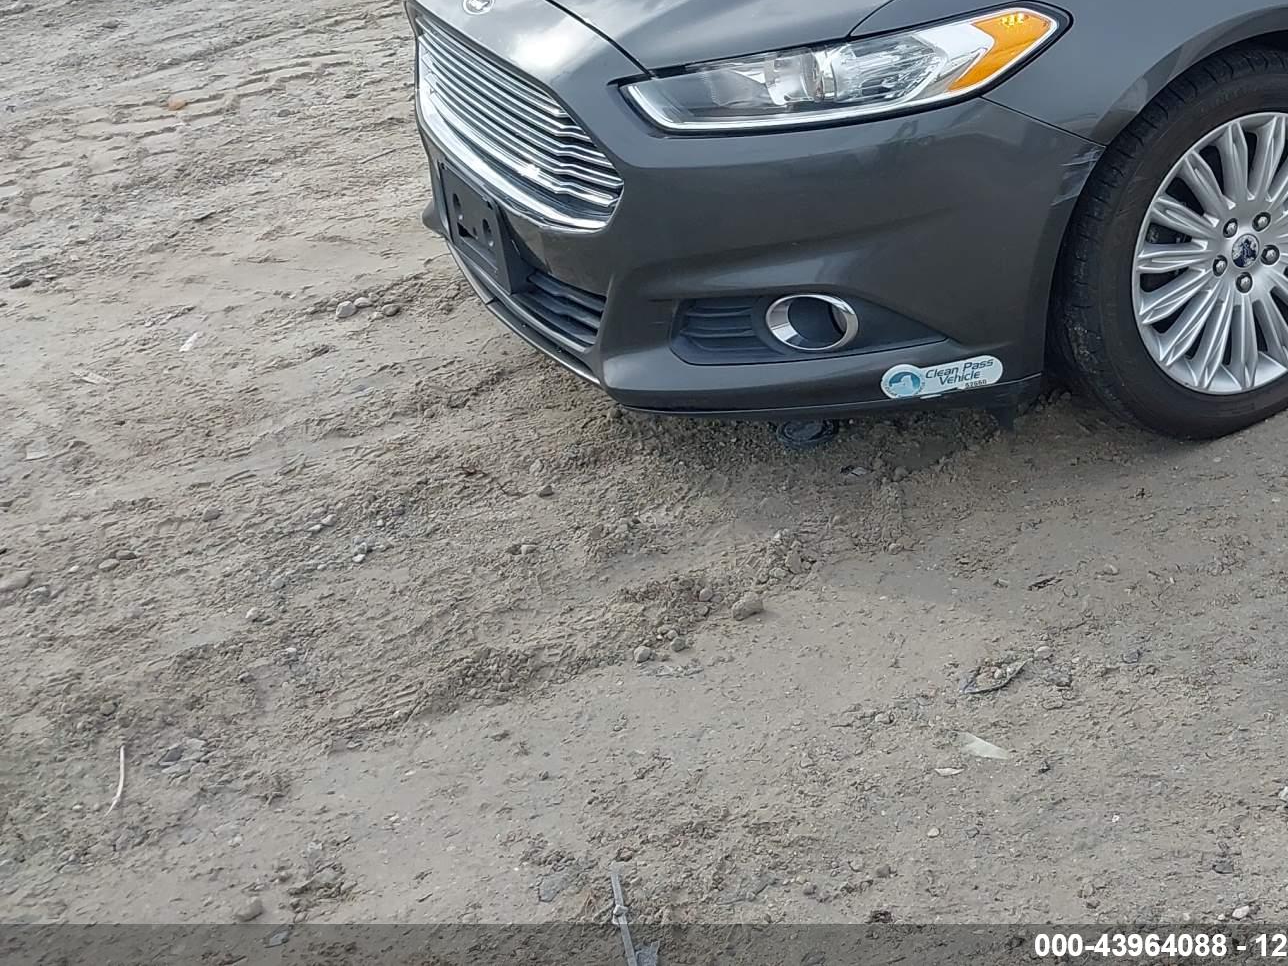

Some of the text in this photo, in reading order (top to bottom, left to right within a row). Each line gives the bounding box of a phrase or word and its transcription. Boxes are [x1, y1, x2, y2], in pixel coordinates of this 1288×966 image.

[925, 358, 994, 379] Clean Pass
[939, 370, 981, 385] Vehicle
